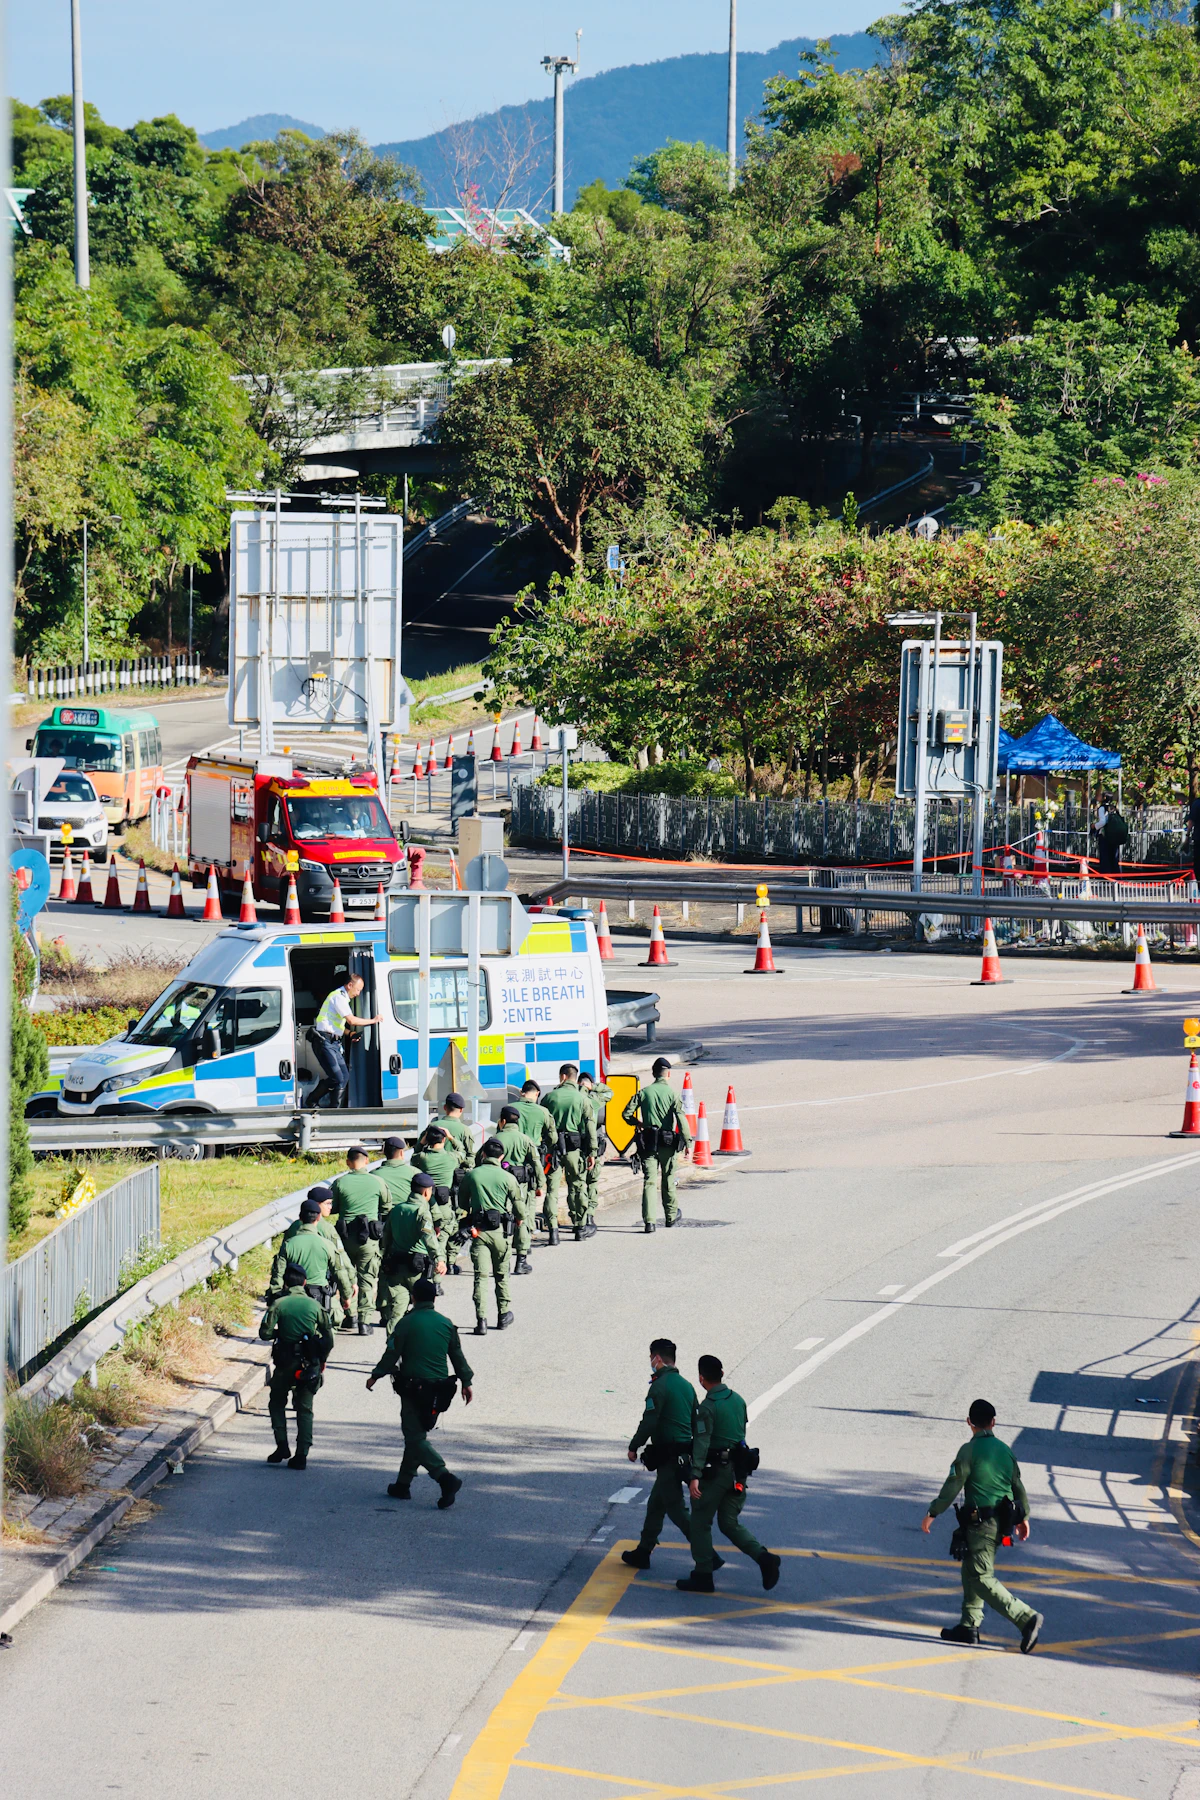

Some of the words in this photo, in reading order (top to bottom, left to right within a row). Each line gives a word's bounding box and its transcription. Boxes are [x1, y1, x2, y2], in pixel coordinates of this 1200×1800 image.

[504, 966, 584, 983] 氣測試中心
[532, 985, 584, 1001] BREATH
[462, 1045, 494, 1055] PICE
